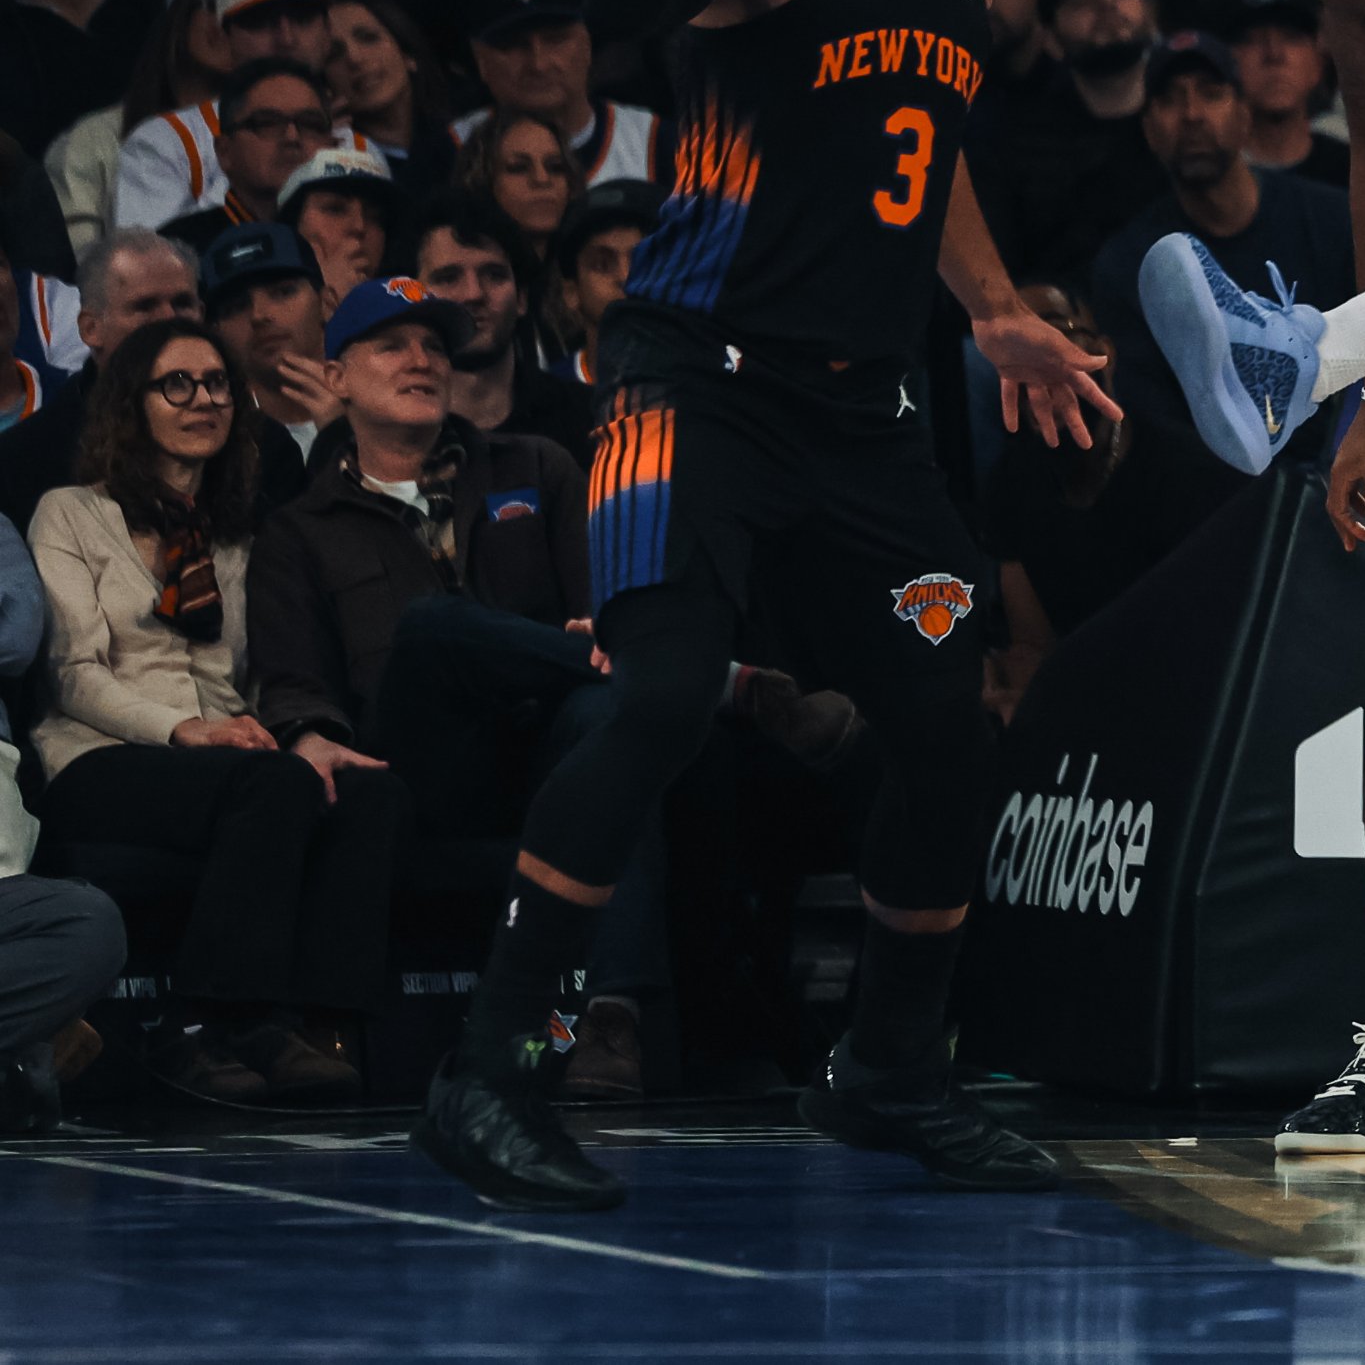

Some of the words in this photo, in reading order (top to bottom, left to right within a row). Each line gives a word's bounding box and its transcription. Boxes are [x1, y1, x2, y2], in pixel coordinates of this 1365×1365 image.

[812, 28, 910, 90] NEW
[870, 104, 937, 231] 3
[897, 581, 970, 612] KNICKS
[985, 752, 1154, 917] coinbase
[402, 972, 450, 995] SECTION
